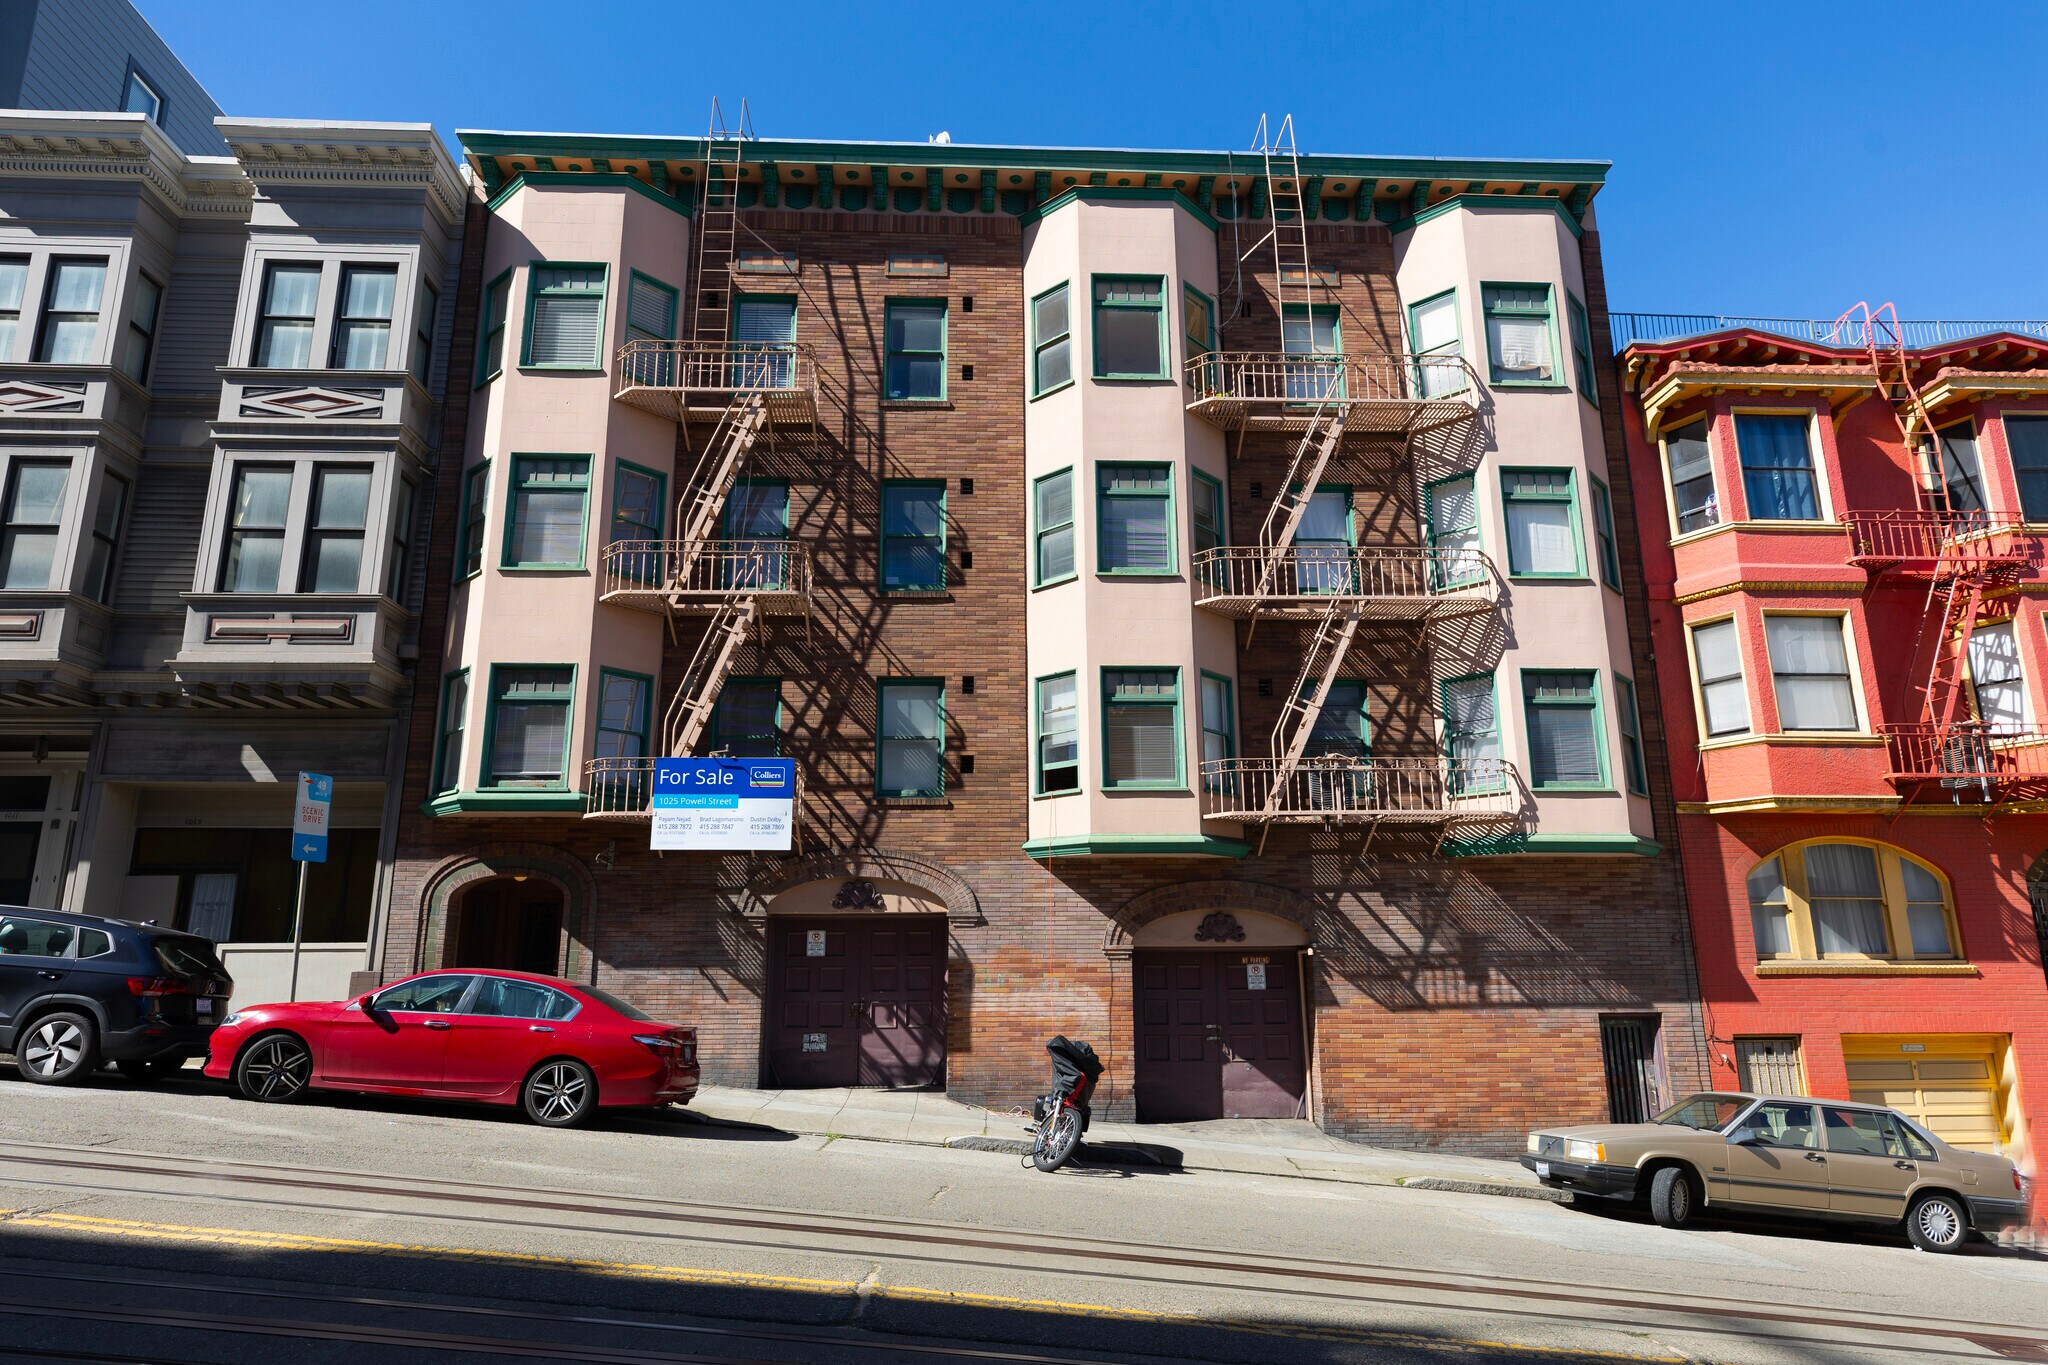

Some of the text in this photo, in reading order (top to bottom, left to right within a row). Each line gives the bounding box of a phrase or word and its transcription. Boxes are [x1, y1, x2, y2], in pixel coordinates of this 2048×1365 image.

[659, 768, 734, 785] For Sale
[754, 770, 782, 779] Colliers
[317, 780, 327, 790] 49
[659, 797, 732, 805] 1025 Powell Street
[302, 806, 325, 816] SCENIC
[302, 814, 322, 824] DRIVE
